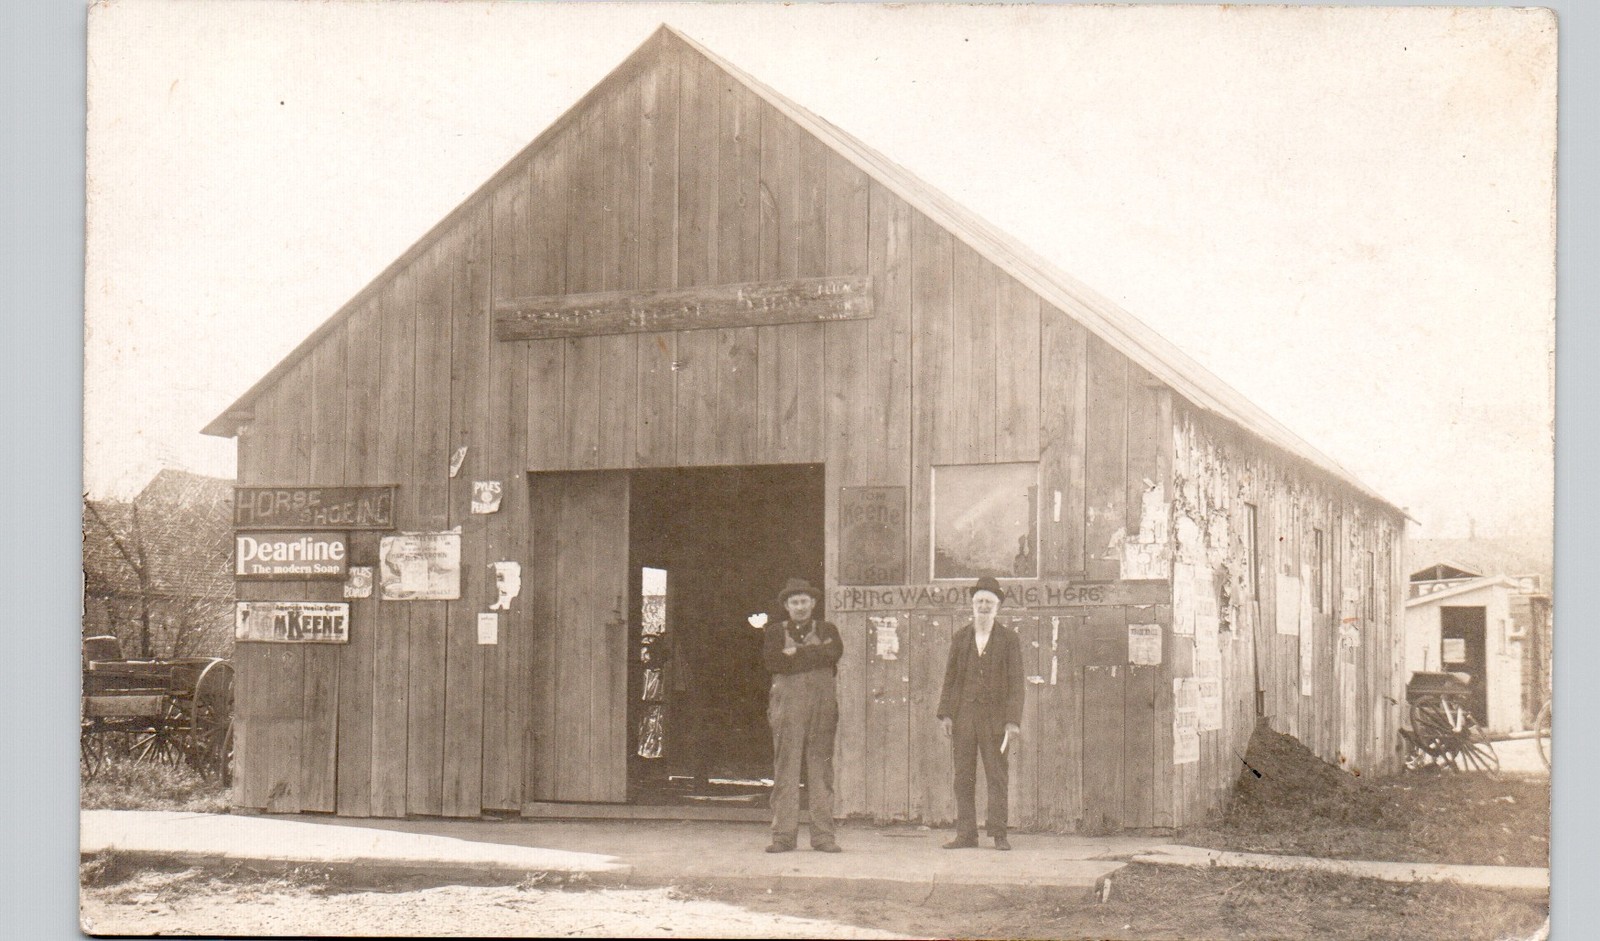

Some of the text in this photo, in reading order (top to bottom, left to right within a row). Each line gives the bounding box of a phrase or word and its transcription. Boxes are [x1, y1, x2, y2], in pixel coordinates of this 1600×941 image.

[237, 489, 321, 522] HORSE
[299, 495, 390, 525] SHOEING
[842, 502, 901, 526] Keene
[236, 537, 345, 575] Pearline
[252, 564, 339, 574] The modern Soap
